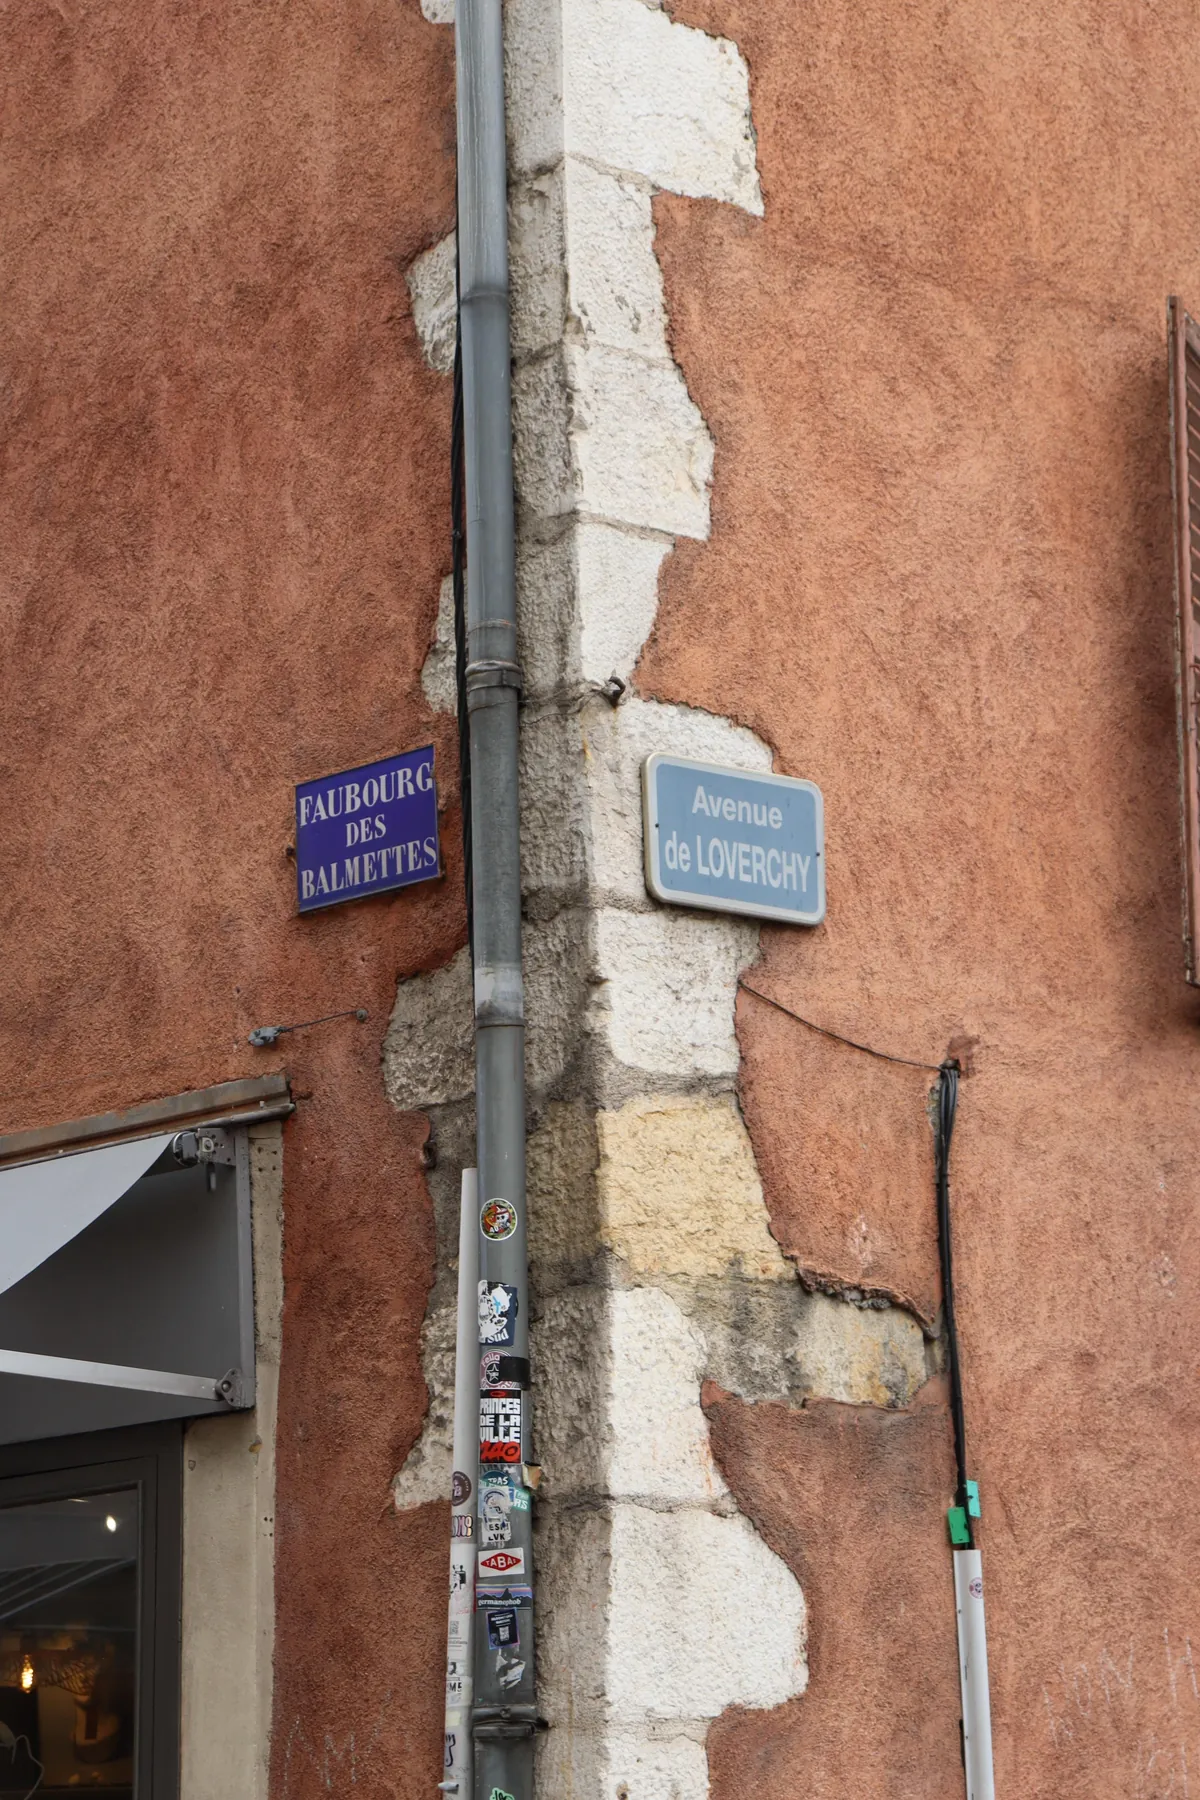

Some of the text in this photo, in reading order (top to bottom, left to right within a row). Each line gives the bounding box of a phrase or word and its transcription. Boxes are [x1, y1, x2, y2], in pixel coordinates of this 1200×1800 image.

[299, 762, 433, 827] FAUBOURG
[692, 785, 783, 829] Avenue
[345, 814, 387, 847] DES
[301, 836, 437, 900] BALMETTES
[665, 831, 811, 892] de LOVERCHY
[480, 1426, 520, 1443] VILLE
[499, 1415, 520, 1426] LA
